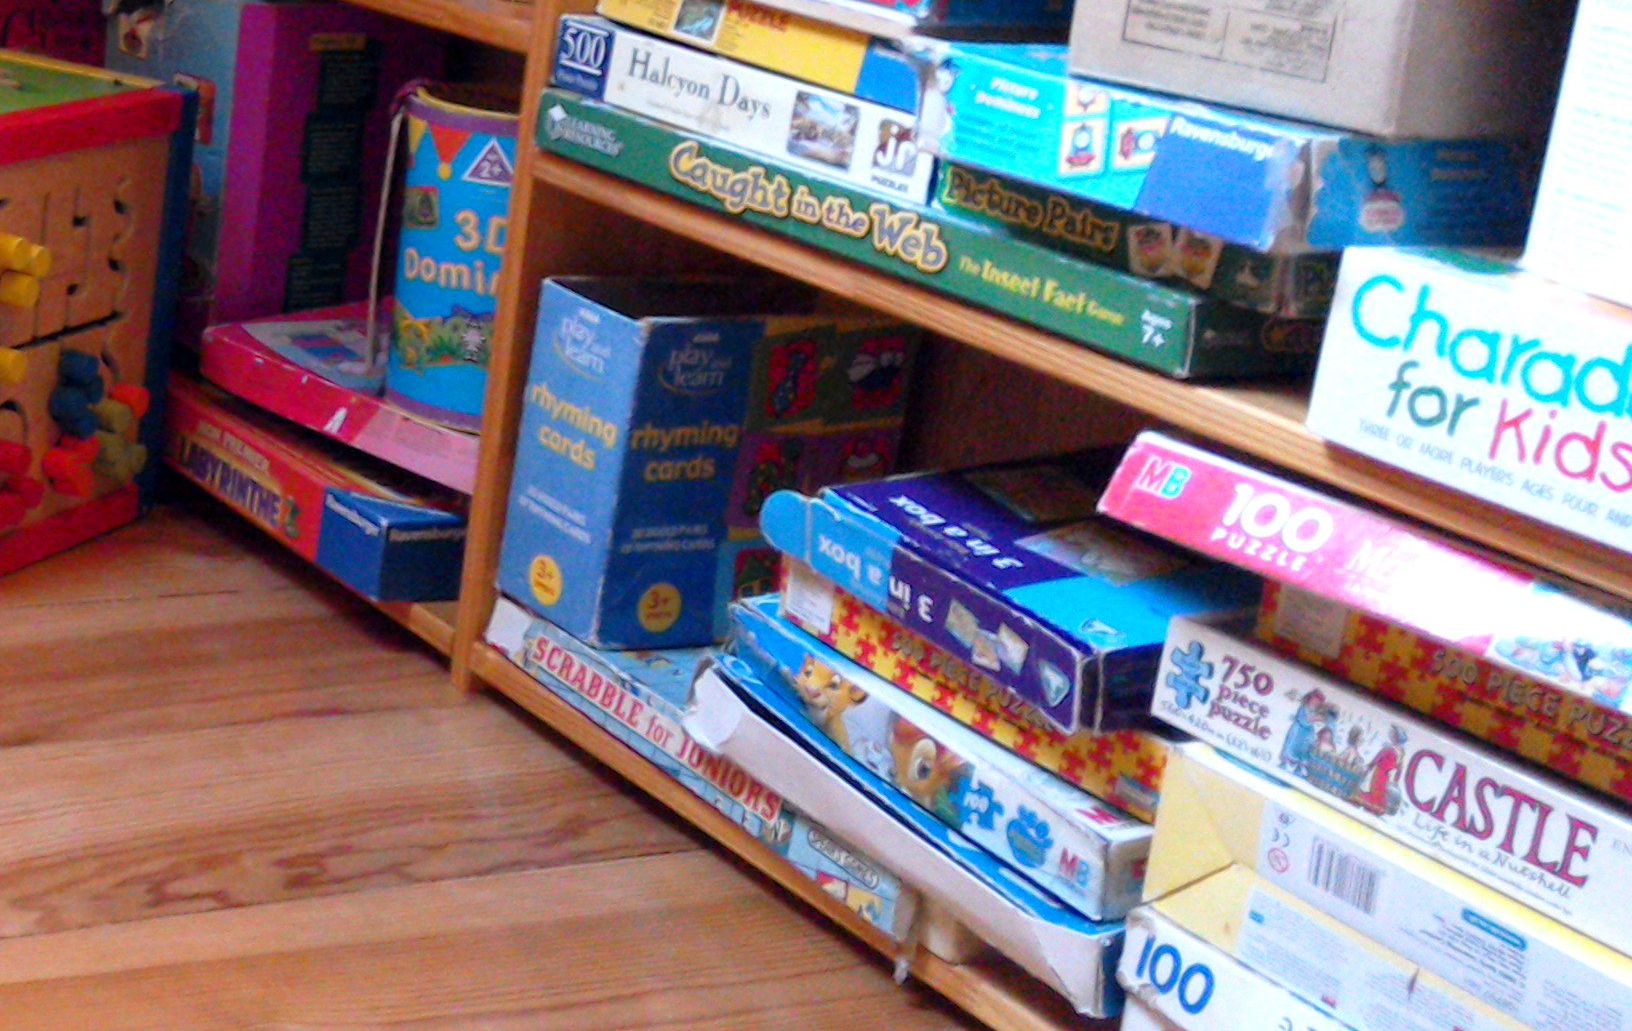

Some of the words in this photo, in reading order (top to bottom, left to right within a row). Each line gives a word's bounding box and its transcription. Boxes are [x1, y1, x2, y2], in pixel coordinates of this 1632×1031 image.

[560, 27, 607, 69] 500
[628, 47, 711, 99] Halcyon
[718, 73, 771, 121] Days
[670, 141, 791, 215] Caught
[793, 186, 820, 223] in
[822, 195, 870, 238] the
[870, 203, 948, 273] Web
[981, 259, 1041, 299] Insect
[1042, 279, 1088, 314] Fact
[1141, 324, 1166, 348] 7+
[1351, 273, 1632, 421] Charad
[530, 382, 619, 449] rhyming
[631, 420, 740, 452] rhyming
[1386, 359, 1481, 437] for
[1487, 398, 1632, 494] Kids
[538, 424, 596, 471] cards
[644, 455, 716, 482] cards
[1358, 418, 1390, 441] THREE
[1396, 433, 1415, 450] OR
[1419, 441, 1454, 465] MORE
[1460, 456, 1515, 487] PLAYERS
[1521, 478, 1555, 501] AGES
[1561, 492, 1599, 517] FOUR
[1135, 453, 1192, 501] MB
[889, 494, 947, 526] box
[1220, 482, 1335, 553] 100
[818, 533, 862, 582] box
[1210, 526, 1308, 572] PUZZLE
[888, 575, 912, 612] in
[917, 593, 934, 624] 3
[531, 635, 645, 729] SCRABBLE
[644, 713, 675, 749] for
[1221, 654, 1275, 697] 750
[1487, 671, 1562, 717] PIECE
[1207, 702, 1273, 740] puzzle
[1217, 684, 1270, 719] piece
[1404, 748, 1599, 889] CASTLE
[1058, 846, 1092, 889] MB
[1414, 811, 1450, 843] Life
[1454, 835, 1473, 853] in
[1491, 850, 1572, 899] Nutshell
[1135, 934, 1216, 1016] 100
